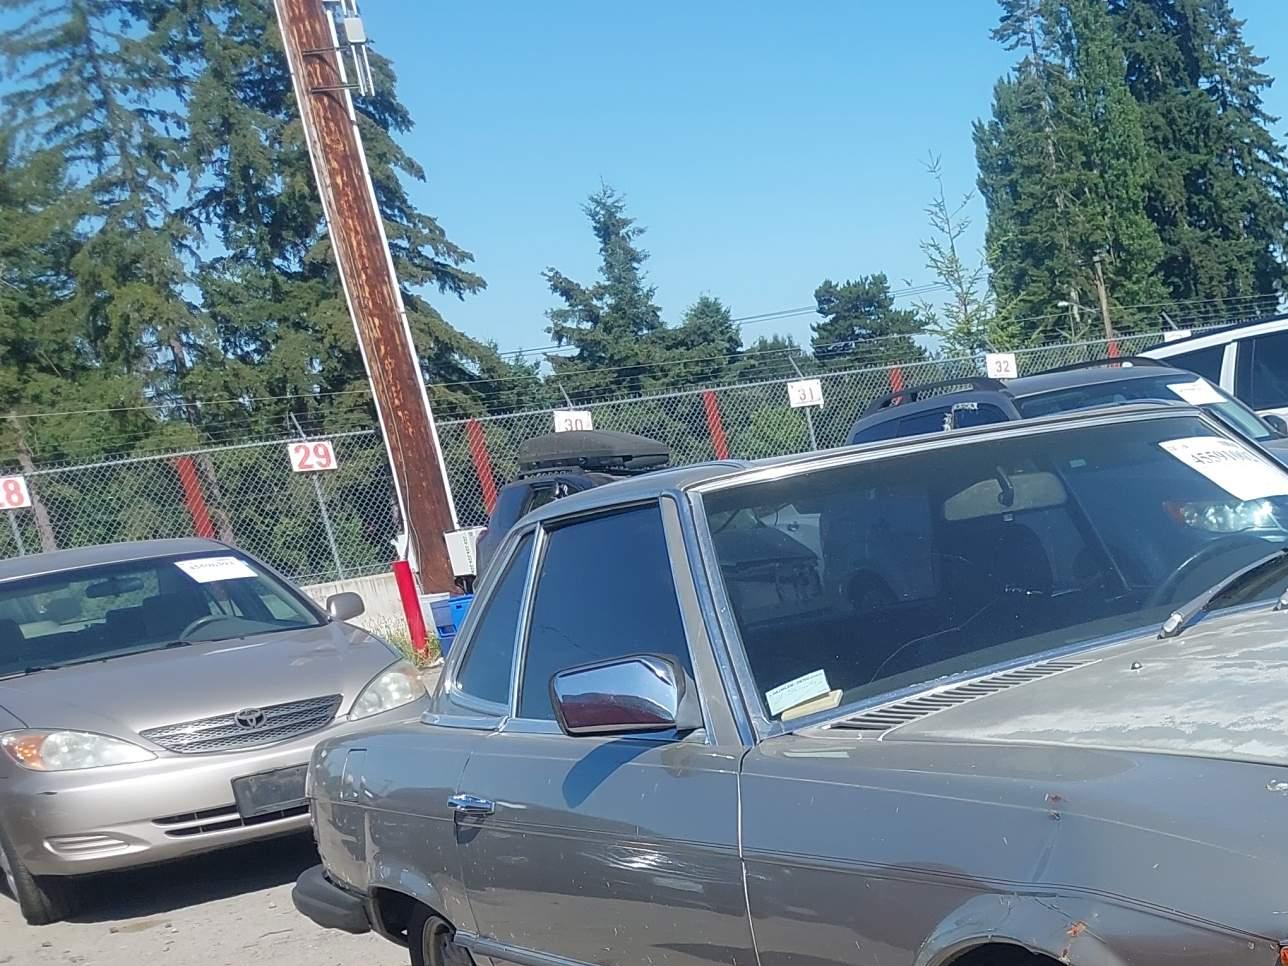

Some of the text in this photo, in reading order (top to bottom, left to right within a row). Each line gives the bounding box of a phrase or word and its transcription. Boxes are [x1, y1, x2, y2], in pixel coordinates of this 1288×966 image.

[994, 359, 1011, 373] 32
[797, 385, 814, 401] 31
[563, 418, 584, 431] 30
[296, 442, 333, 470] 29
[2, 479, 24, 507] 8
